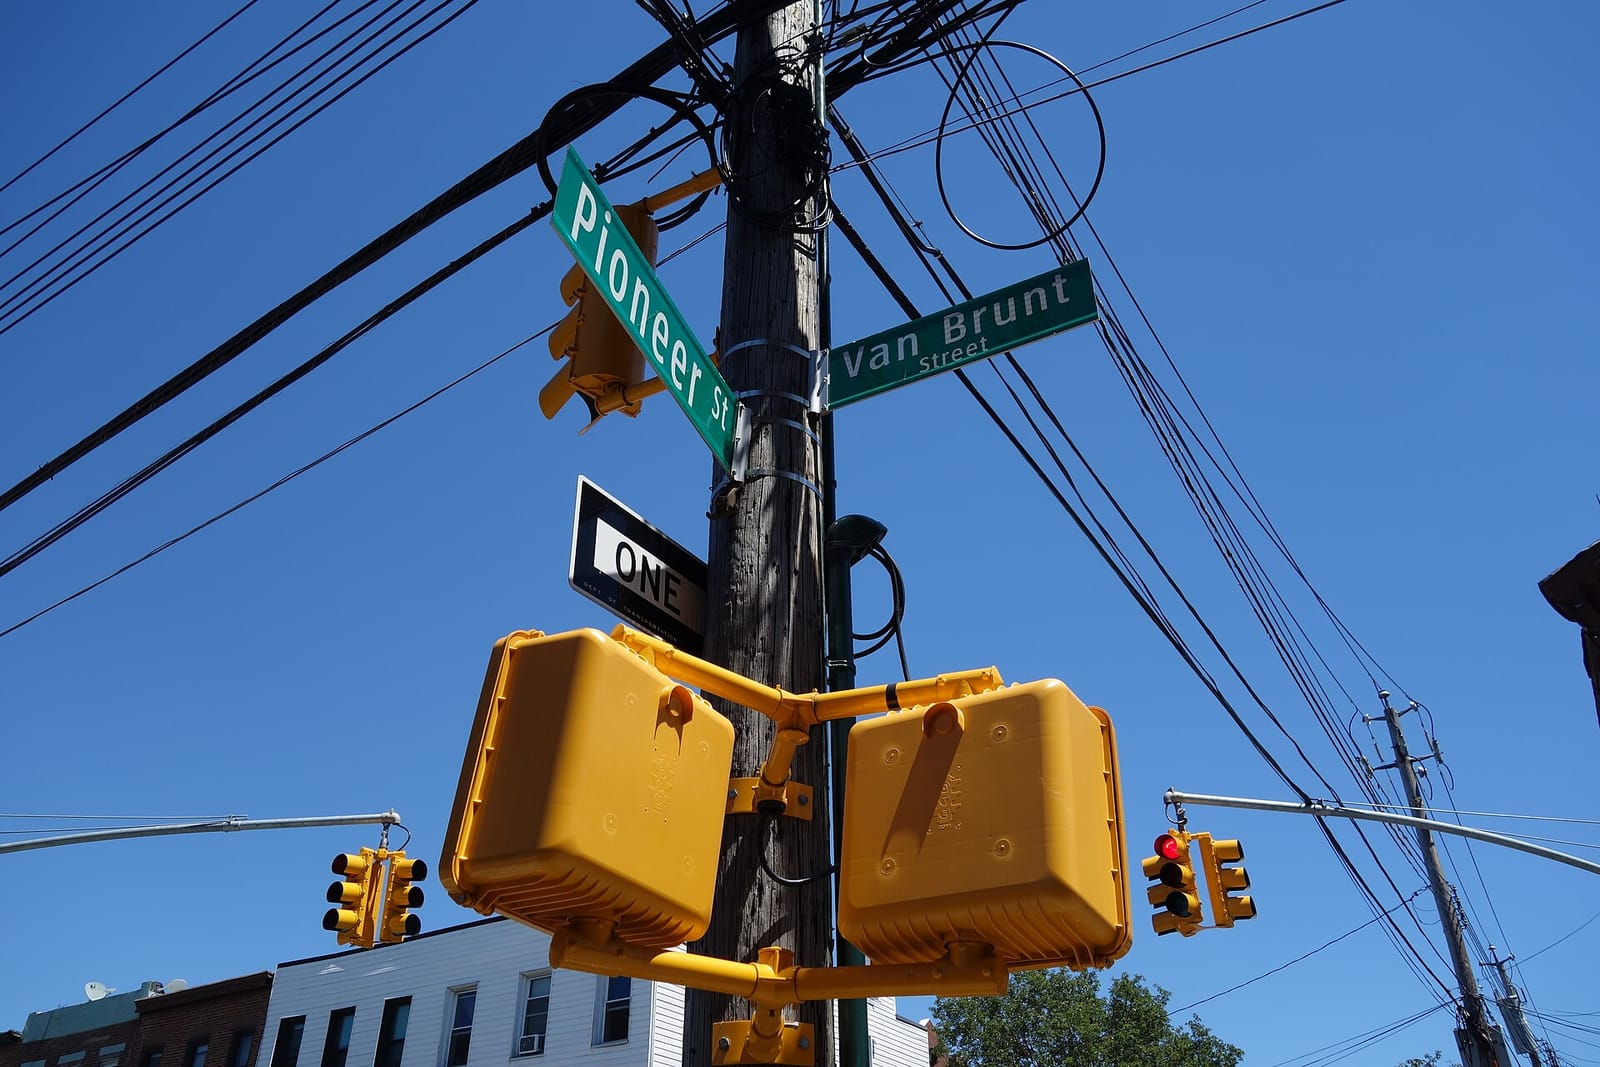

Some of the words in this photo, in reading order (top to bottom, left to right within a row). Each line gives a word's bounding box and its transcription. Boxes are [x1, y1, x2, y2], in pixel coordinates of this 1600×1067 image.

[570, 181, 702, 407] Pioneer
[712, 385, 728, 432] St
[842, 333, 919, 378] Van
[943, 273, 1070, 345] Brunt
[919, 336, 989, 373] Street
[615, 541, 682, 617] ONE
